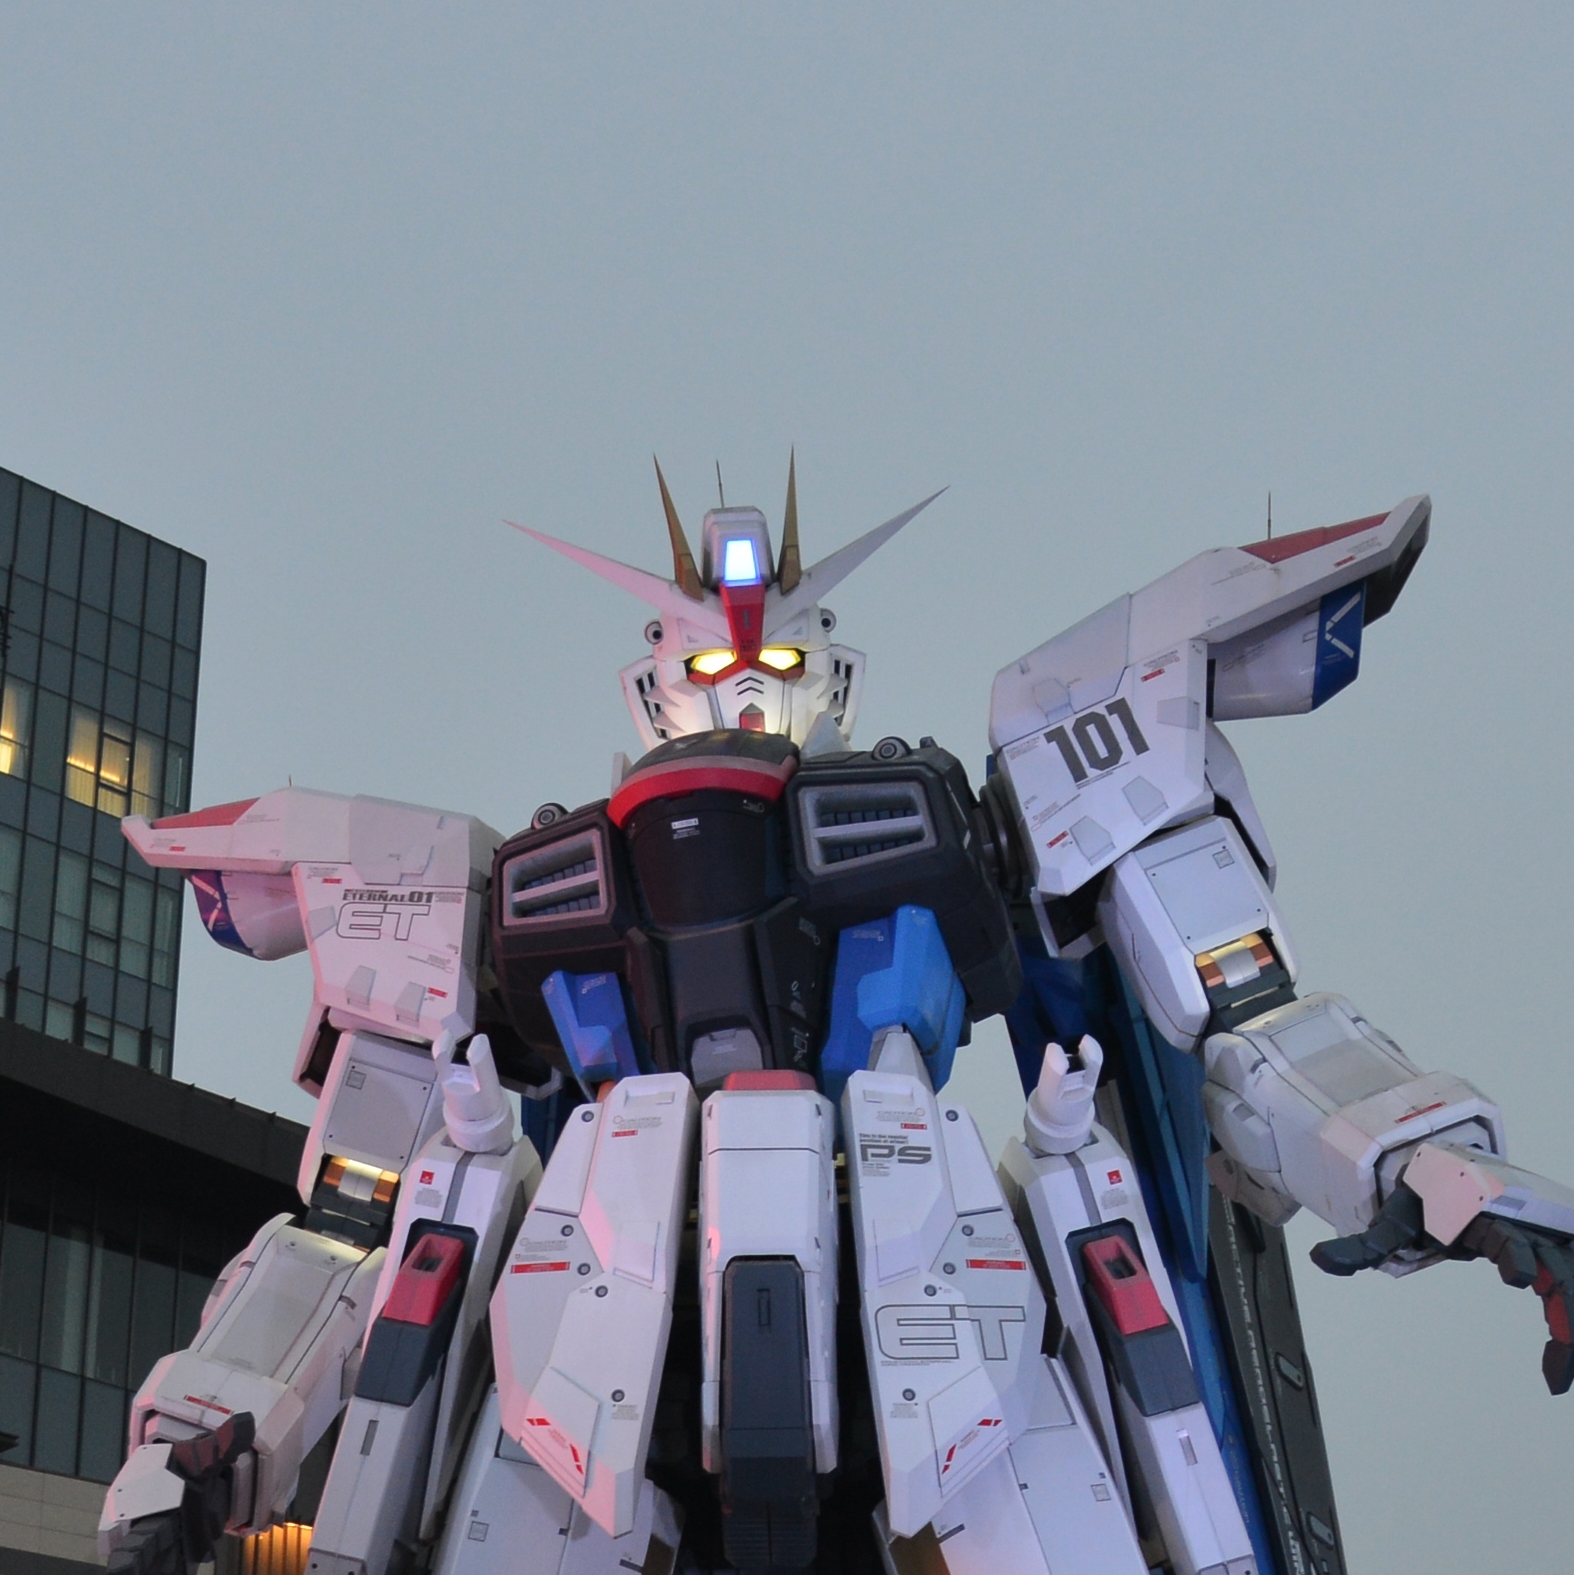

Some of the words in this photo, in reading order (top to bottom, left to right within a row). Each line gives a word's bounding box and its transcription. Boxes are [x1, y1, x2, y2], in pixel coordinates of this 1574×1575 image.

[1043, 697, 1150, 783] 101
[336, 902, 432, 942] ET
[860, 1144, 932, 1165] PS
[875, 1304, 1026, 1361] ET
